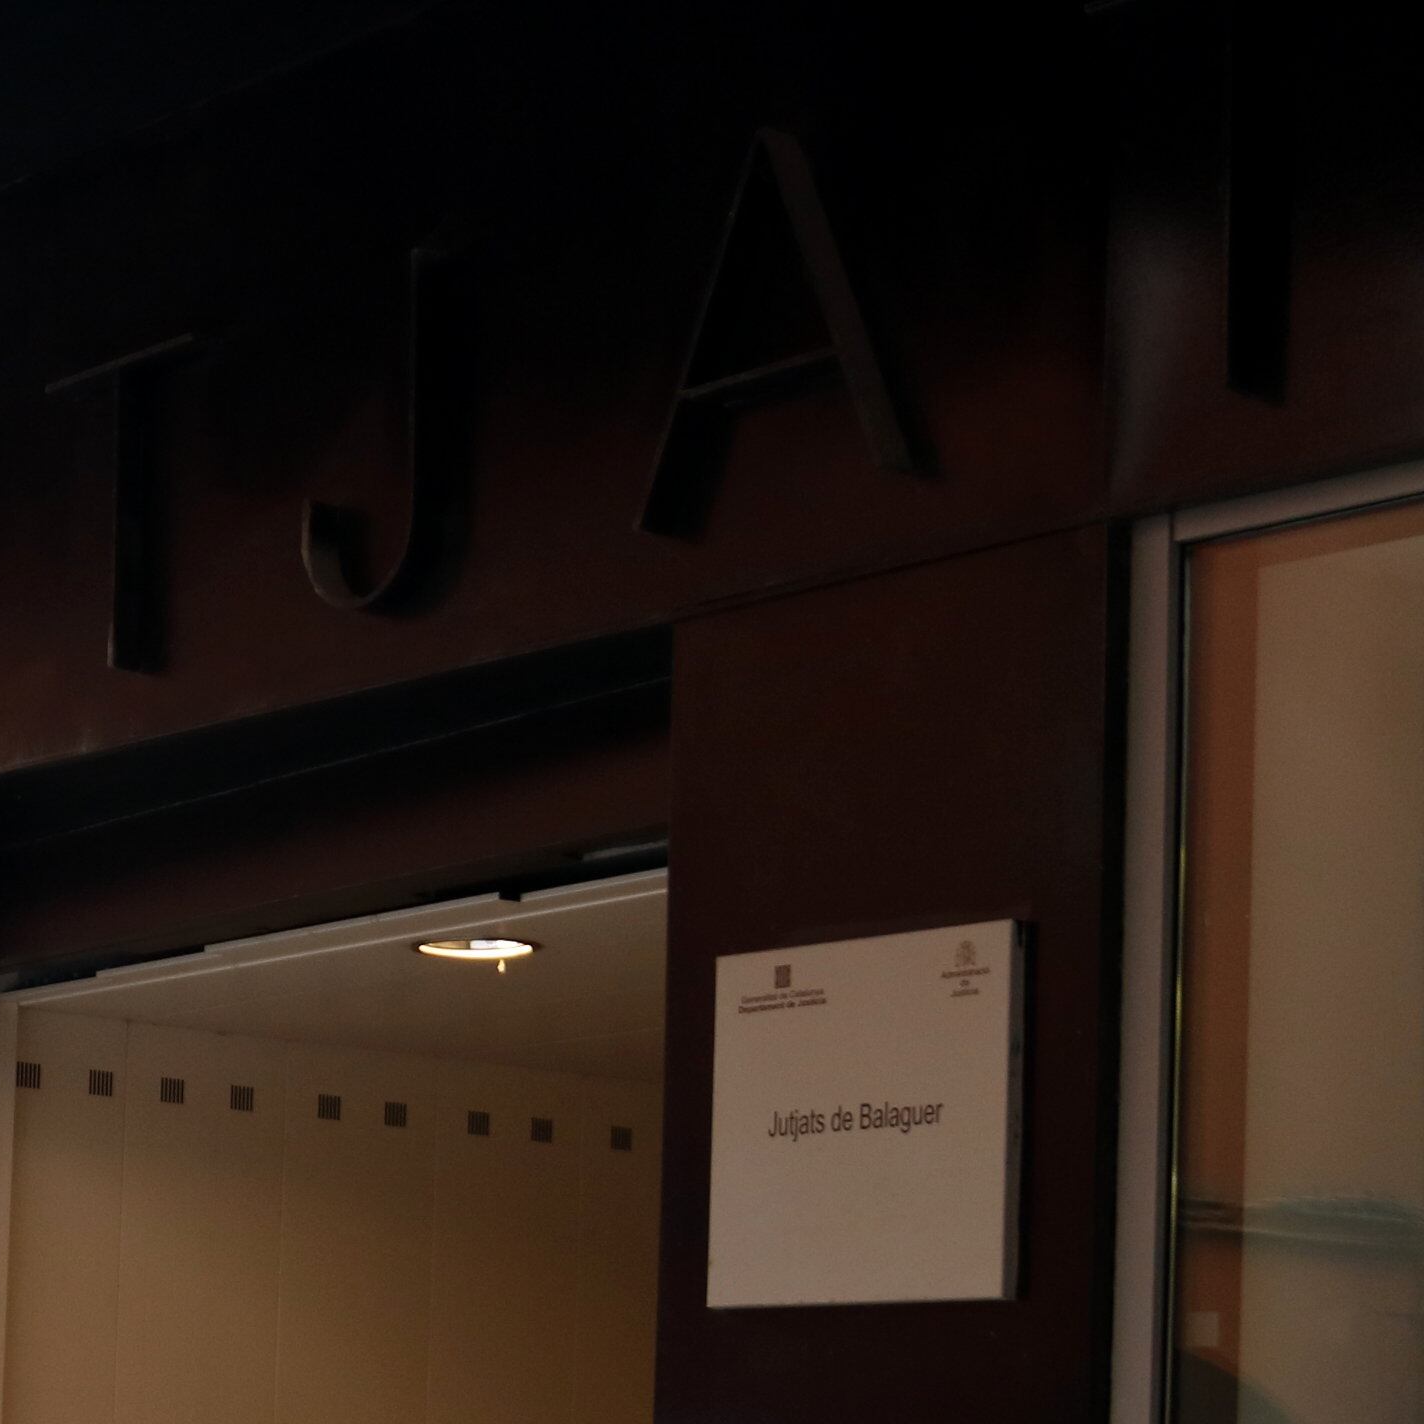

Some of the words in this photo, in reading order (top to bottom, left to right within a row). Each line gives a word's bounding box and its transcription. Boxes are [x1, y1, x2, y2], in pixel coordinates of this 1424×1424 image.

[768, 1109, 825, 1142] Jutjats
[830, 1105, 853, 1132] de
[859, 1101, 943, 1134] Balaguer
